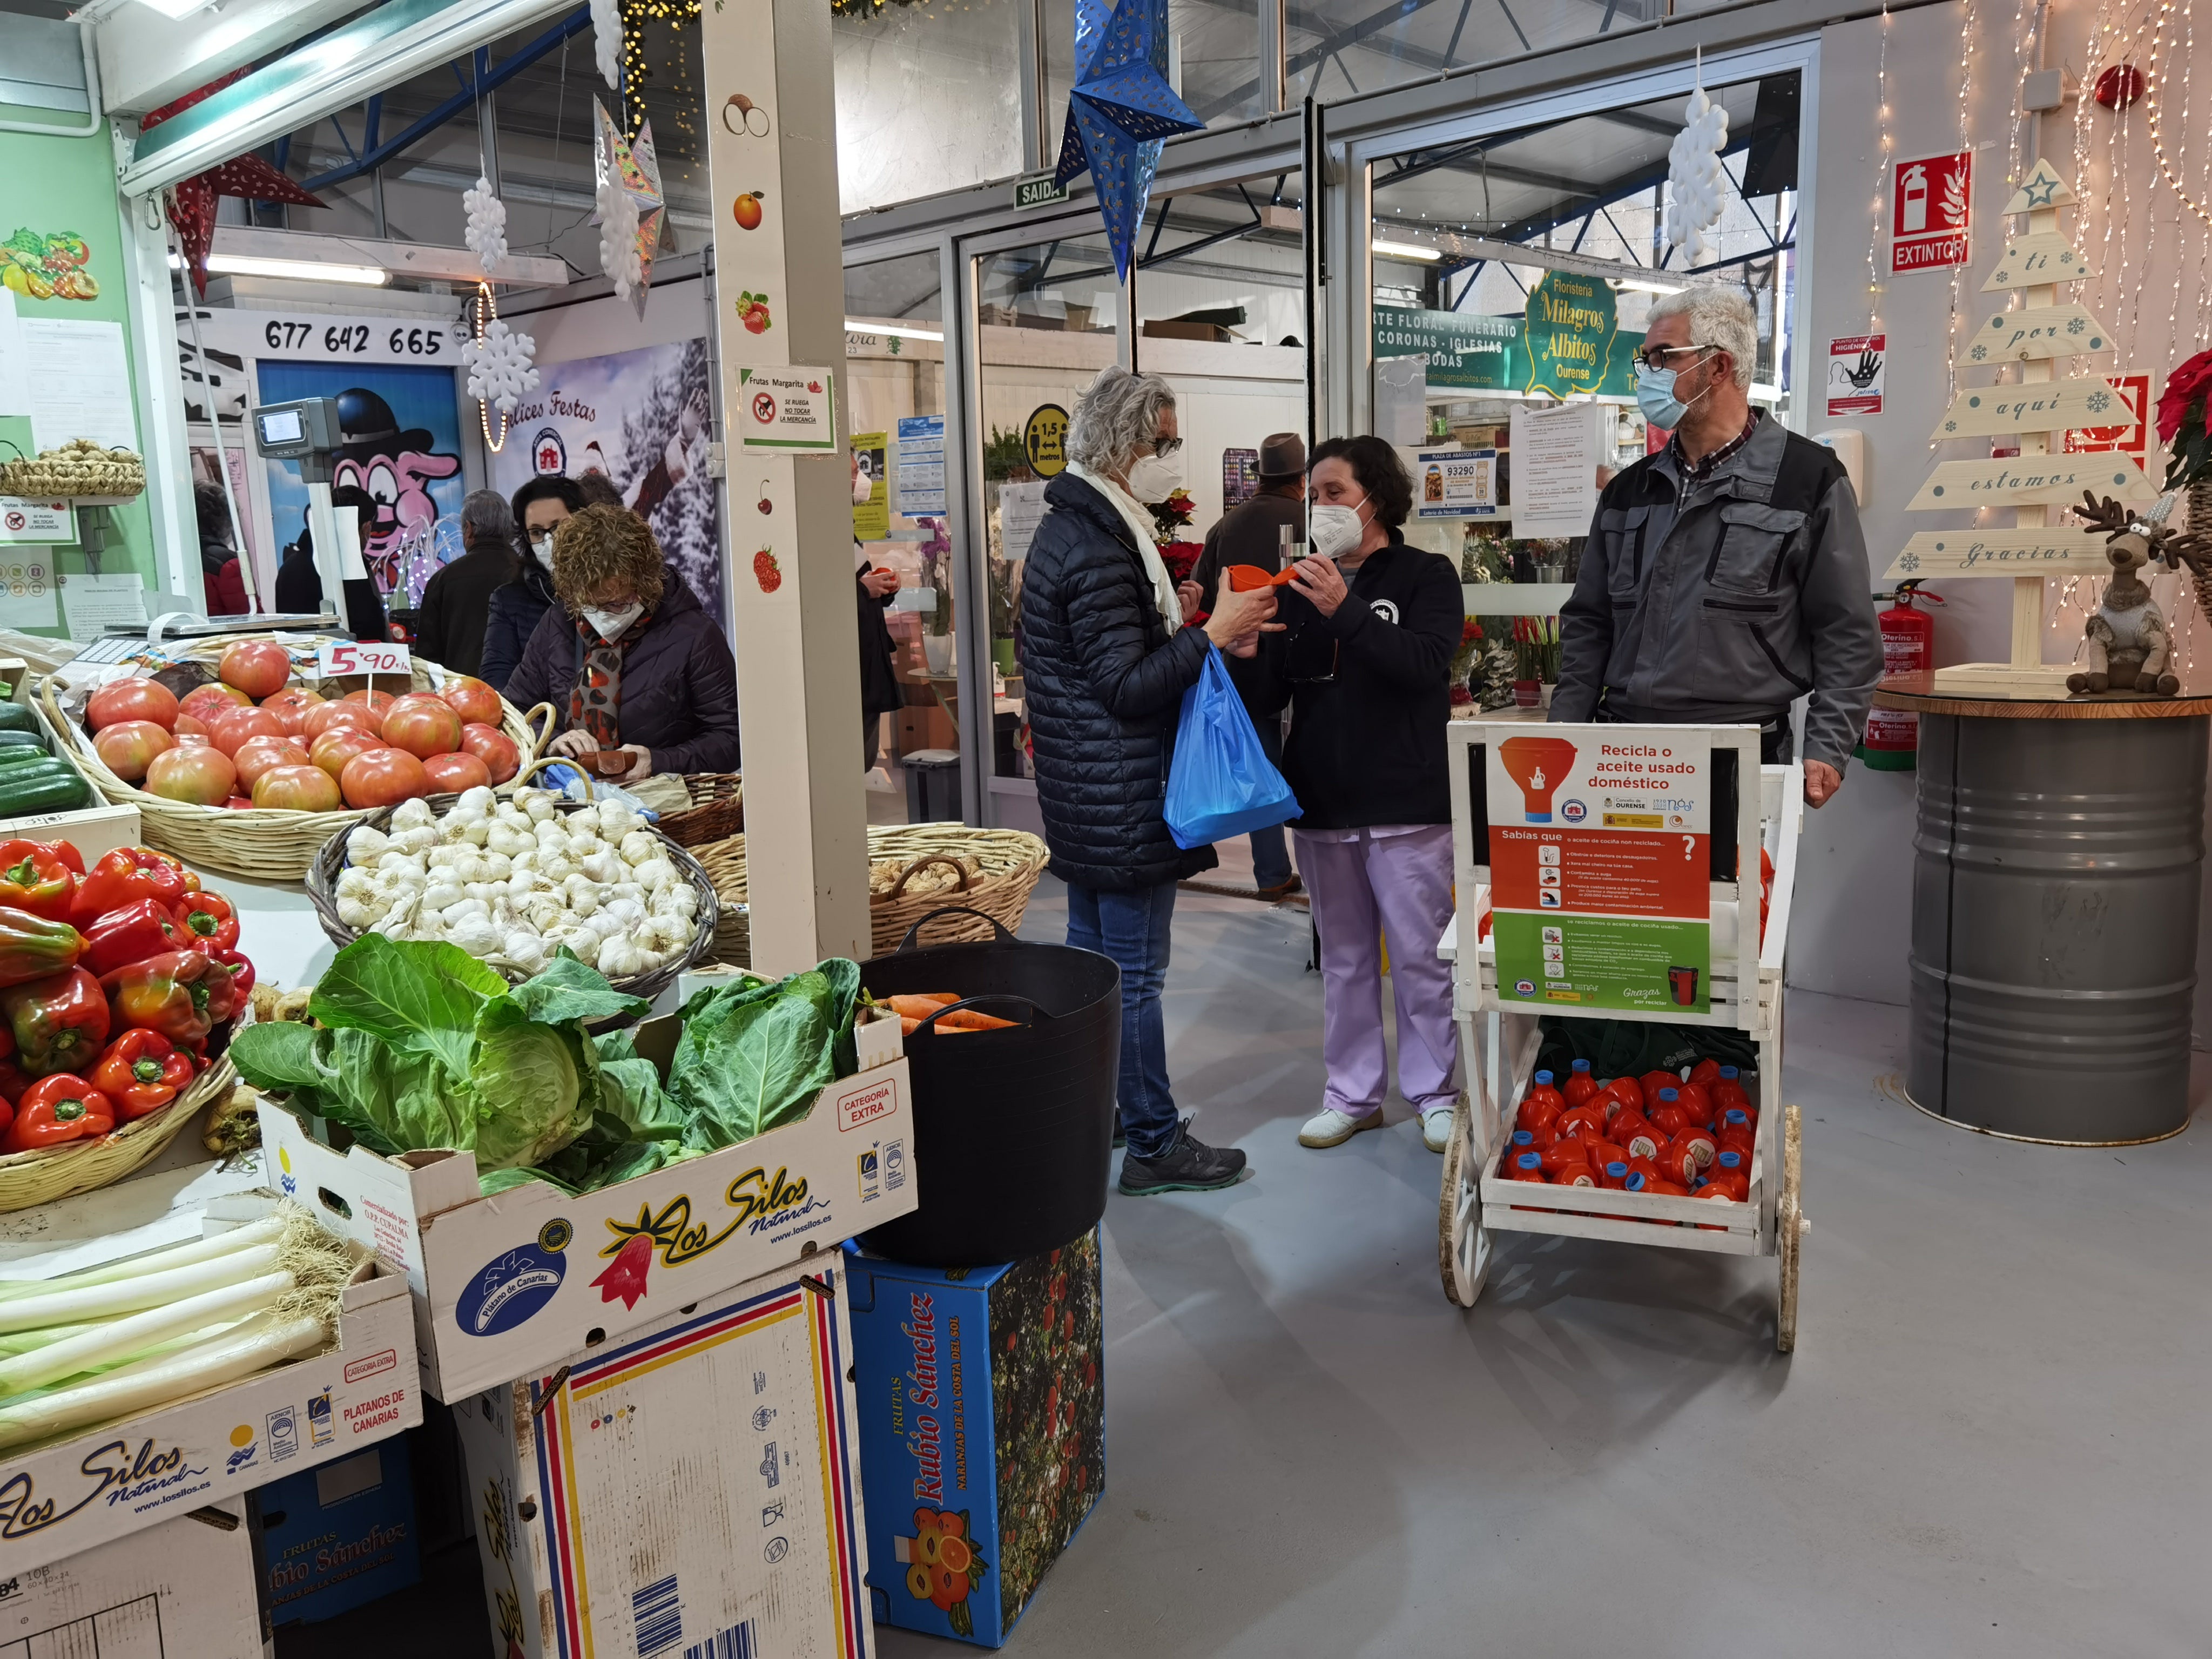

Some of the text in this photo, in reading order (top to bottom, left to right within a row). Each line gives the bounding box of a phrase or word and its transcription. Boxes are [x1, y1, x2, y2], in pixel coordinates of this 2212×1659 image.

[1022, 181, 1060, 203] SAIDA
[1897, 240, 1963, 265] EXTINTOR
[2026, 251, 2047, 271] ti
[1554, 279, 1593, 297] Floristeria
[1541, 292, 1604, 334] Milagros
[266, 321, 443, 355] 677 642 665
[1399, 314, 1444, 331] FLORAL
[1452, 320, 1516, 338] FUNERARIO
[2006, 326, 2057, 349] por
[1378, 331, 1502, 353] CORONAS IGLESIAS
[1542, 332, 1596, 366] Albitos
[1425, 353, 1462, 367] BODAS
[1556, 363, 1590, 380] Ourense
[750, 377, 804, 388] Frutas Margarita
[505, 391, 595, 434] elices Festas
[1997, 394, 2060, 420] aquí
[1042, 422, 1057, 437] 1,5
[1040, 453, 1060, 461] metros
[1447, 466, 1474, 475] 93290
[1971, 471, 2075, 491] estamos
[1959, 543, 2069, 568] Gracias
[1602, 745, 1671, 757] Recicla o
[1597, 761, 1695, 774] aceite usado
[1588, 776, 1669, 789] doméstico
[1502, 831, 1538, 840] Sabías
[1682, 835, 1695, 861] ?
[1623, 988, 1661, 1000] Grazas
[845, 1087, 889, 1111] CATEGORÍA
[851, 1101, 884, 1122] EXTRA
[886, 1143, 901, 1152] AENOR
[727, 1167, 808, 1218] Silos
[360, 1195, 409, 1227] Comercializado por:
[749, 1196, 830, 1235] Natural
[365, 1209, 409, 1239] O.P.P. CUPALMA
[771, 1214, 832, 1244] www.lossilos.es
[482, 1273, 548, 1317] Plátano de Canarias
[348, 1355, 394, 1377] CATEGORIA EXTRA
[344, 1390, 404, 1421] PLATANOS DE
[891, 1377, 904, 1435] FRUTAS
[901, 1292, 943, 1506] Rubio Sánchez
[949, 1316, 967, 1491] NARANJAS DE LA COSTA DEL SOL
[270, 1410, 291, 1420] AENOR
[353, 1408, 398, 1433] CANARIAS
[273, 1440, 293, 1450] Ambiente
[82, 1438, 181, 1485] Silos
[239, 1460, 259, 1471] CANARIAS
[106, 1464, 208, 1506] Natural
[134, 1480, 211, 1513] www.lossilos.es
[283, 1531, 336, 1560] FRUTAS
[316, 1523, 407, 1574] Sánchez
[272, 1553, 394, 1607] ANJAS DE LA COSTA DEL SOL
